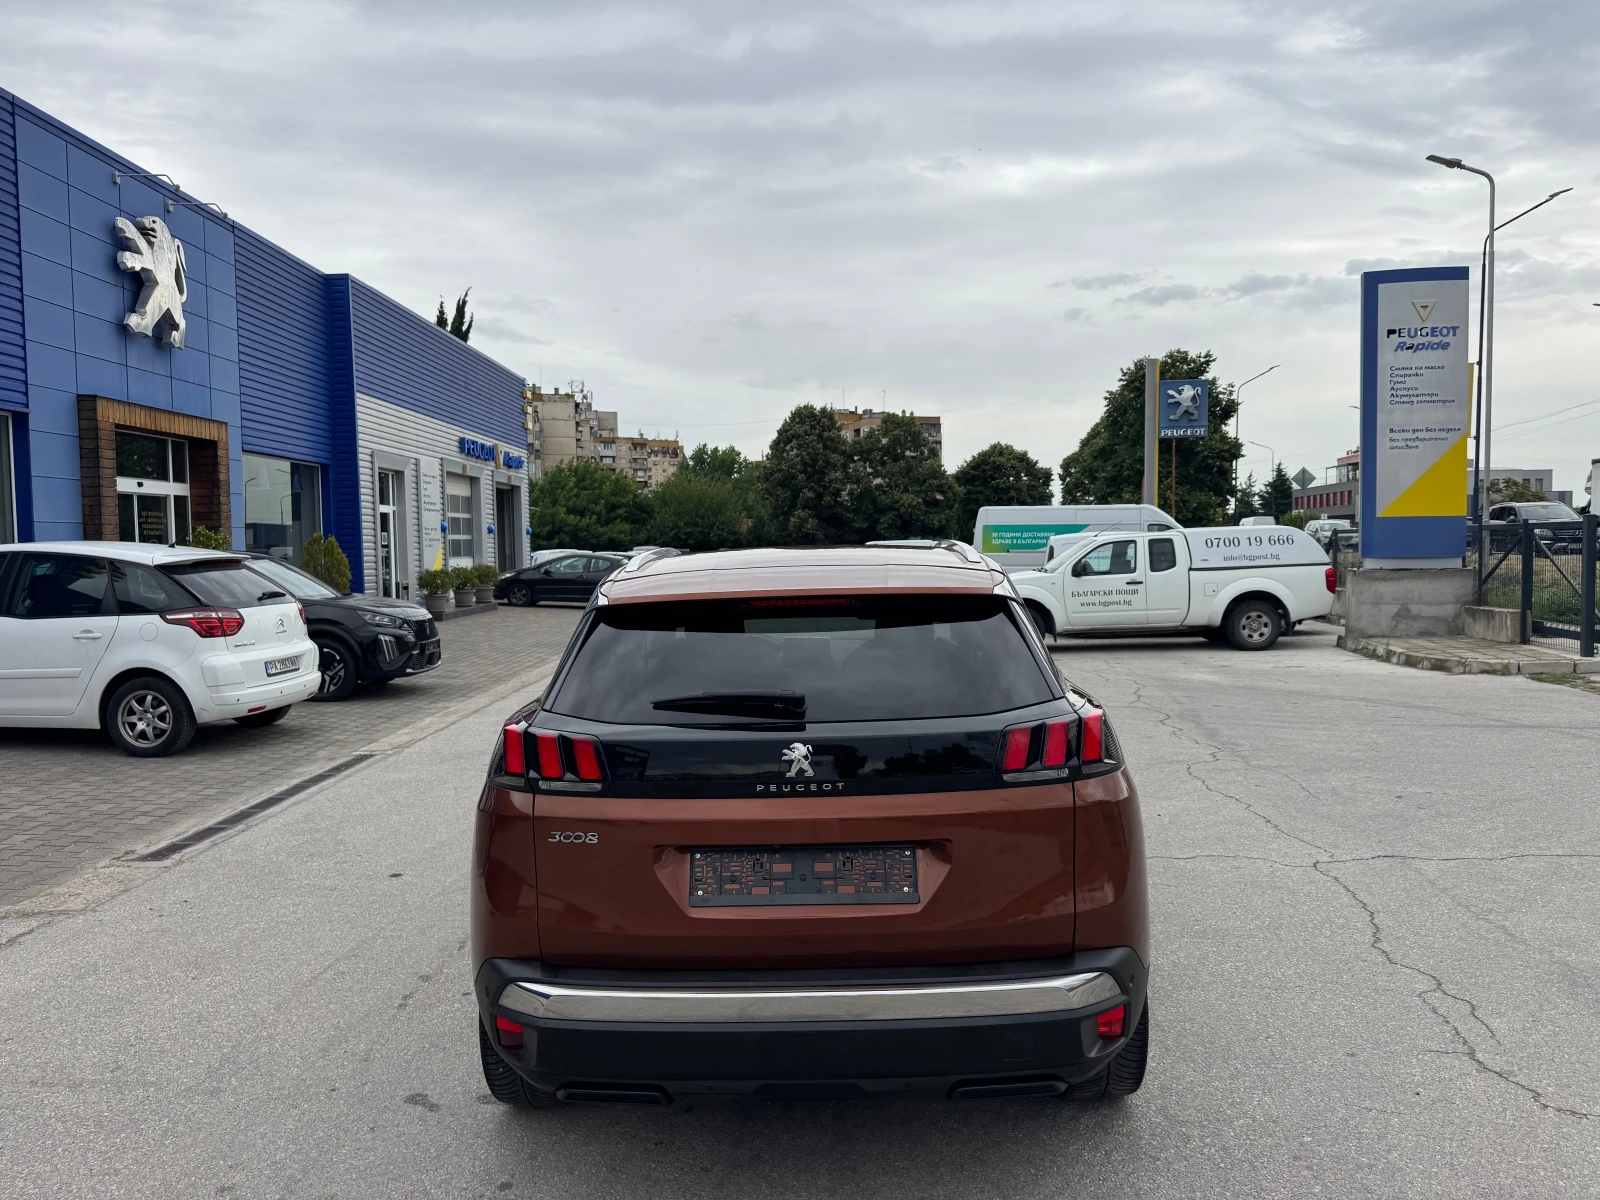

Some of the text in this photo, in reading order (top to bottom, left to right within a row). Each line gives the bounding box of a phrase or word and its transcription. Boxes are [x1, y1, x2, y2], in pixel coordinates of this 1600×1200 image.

[1387, 326, 1460, 338] PEUGEOT
[1394, 340, 1451, 353] Rapide
[1161, 428, 1206, 437] PEUGEOT
[1205, 534, 1294, 548] 0700 19 666
[1223, 553, 1281, 562] info@bgpost.bg
[1071, 588, 1139, 598] БЪЛГАРСКИ ПОЩИ
[1080, 599, 1132, 607] www.bgpost.bg
[756, 782, 845, 792] PEUGEOT
[548, 831, 599, 844] 3008
